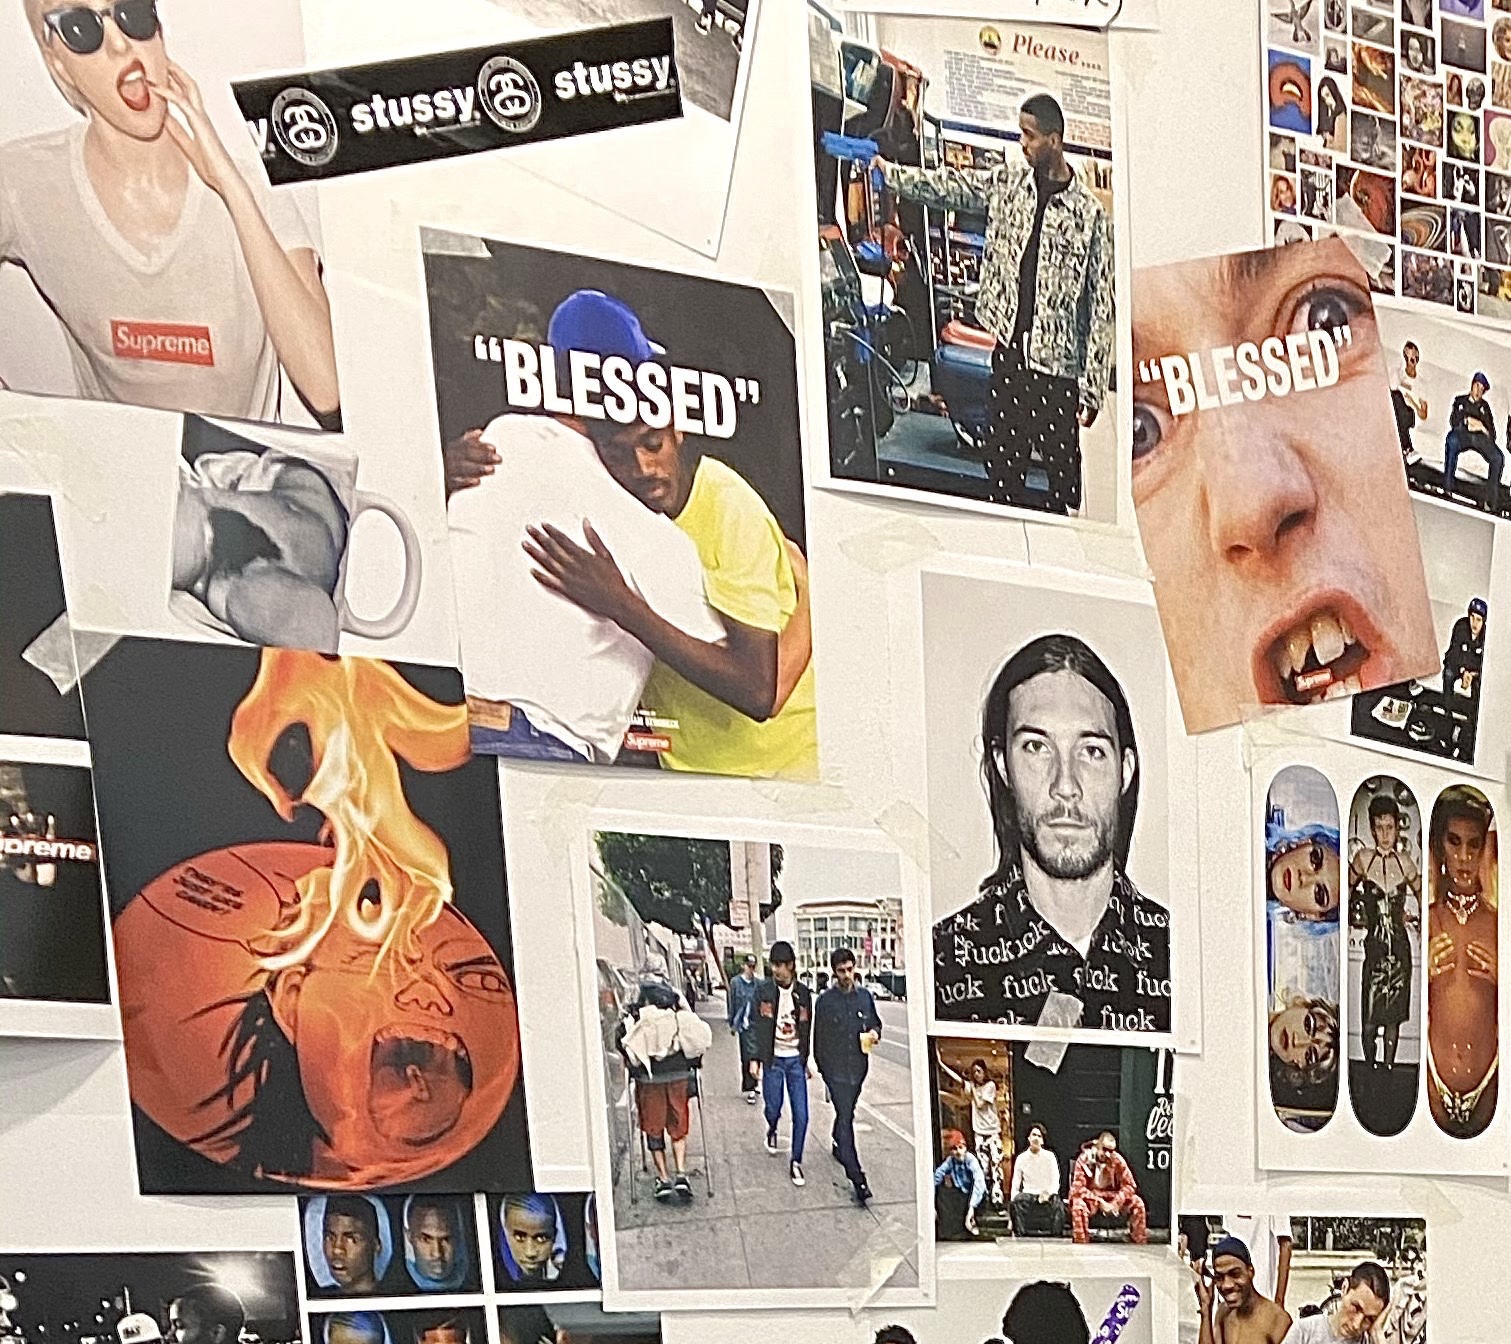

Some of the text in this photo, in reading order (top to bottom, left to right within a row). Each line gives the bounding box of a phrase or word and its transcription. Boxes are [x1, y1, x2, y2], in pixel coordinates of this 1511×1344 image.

[351, 84, 476, 134] stussy
[554, 55, 673, 100] stussy
[116, 325, 210, 357] Supreme
[936, 974, 985, 1004] uck
[1002, 968, 1059, 999] fuck
[1100, 1005, 1157, 1032] fuck
